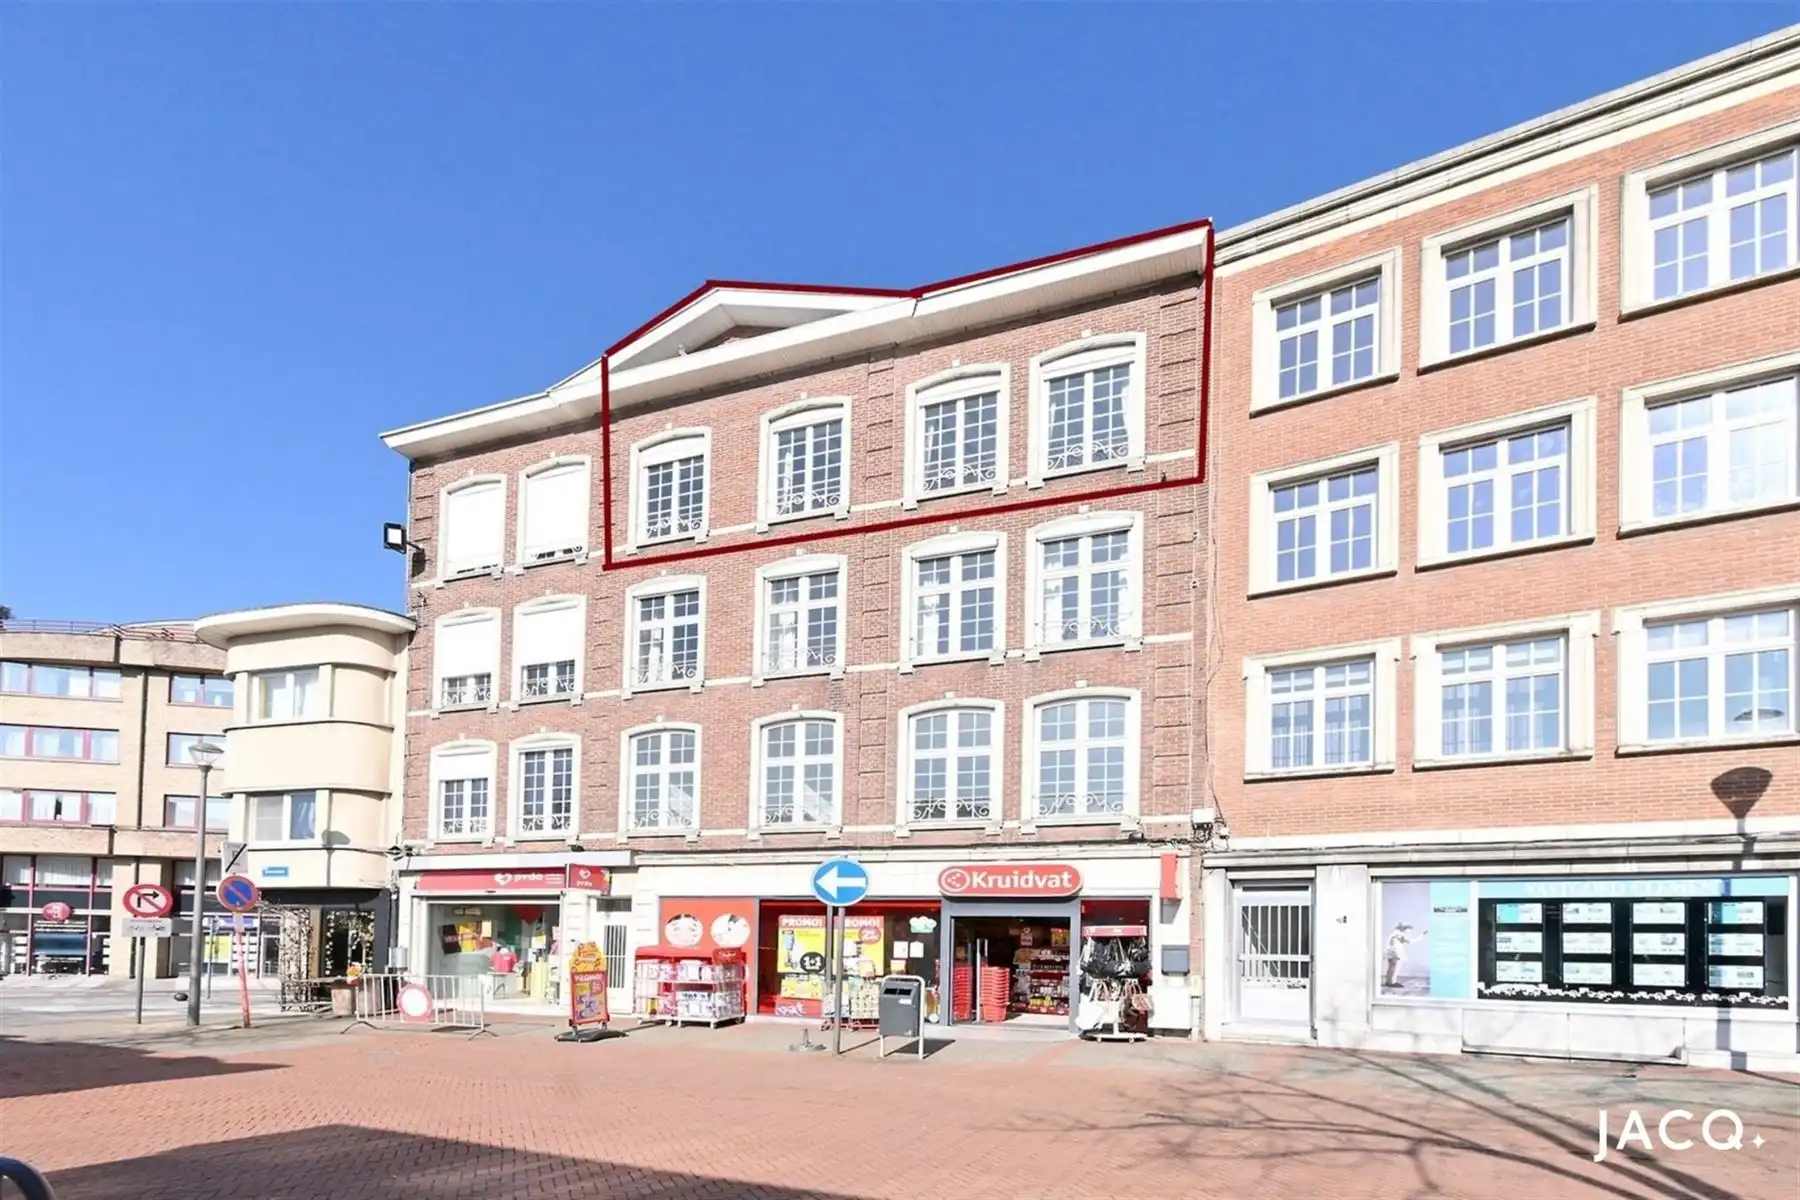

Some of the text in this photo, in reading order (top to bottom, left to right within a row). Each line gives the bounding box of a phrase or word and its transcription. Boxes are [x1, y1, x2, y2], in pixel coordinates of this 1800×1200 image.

[514, 872, 543, 882] pvda
[971, 870, 1073, 889] Kruidvat
[783, 918, 822, 929] PROMO!
[844, 919, 880, 929] ROMO!
